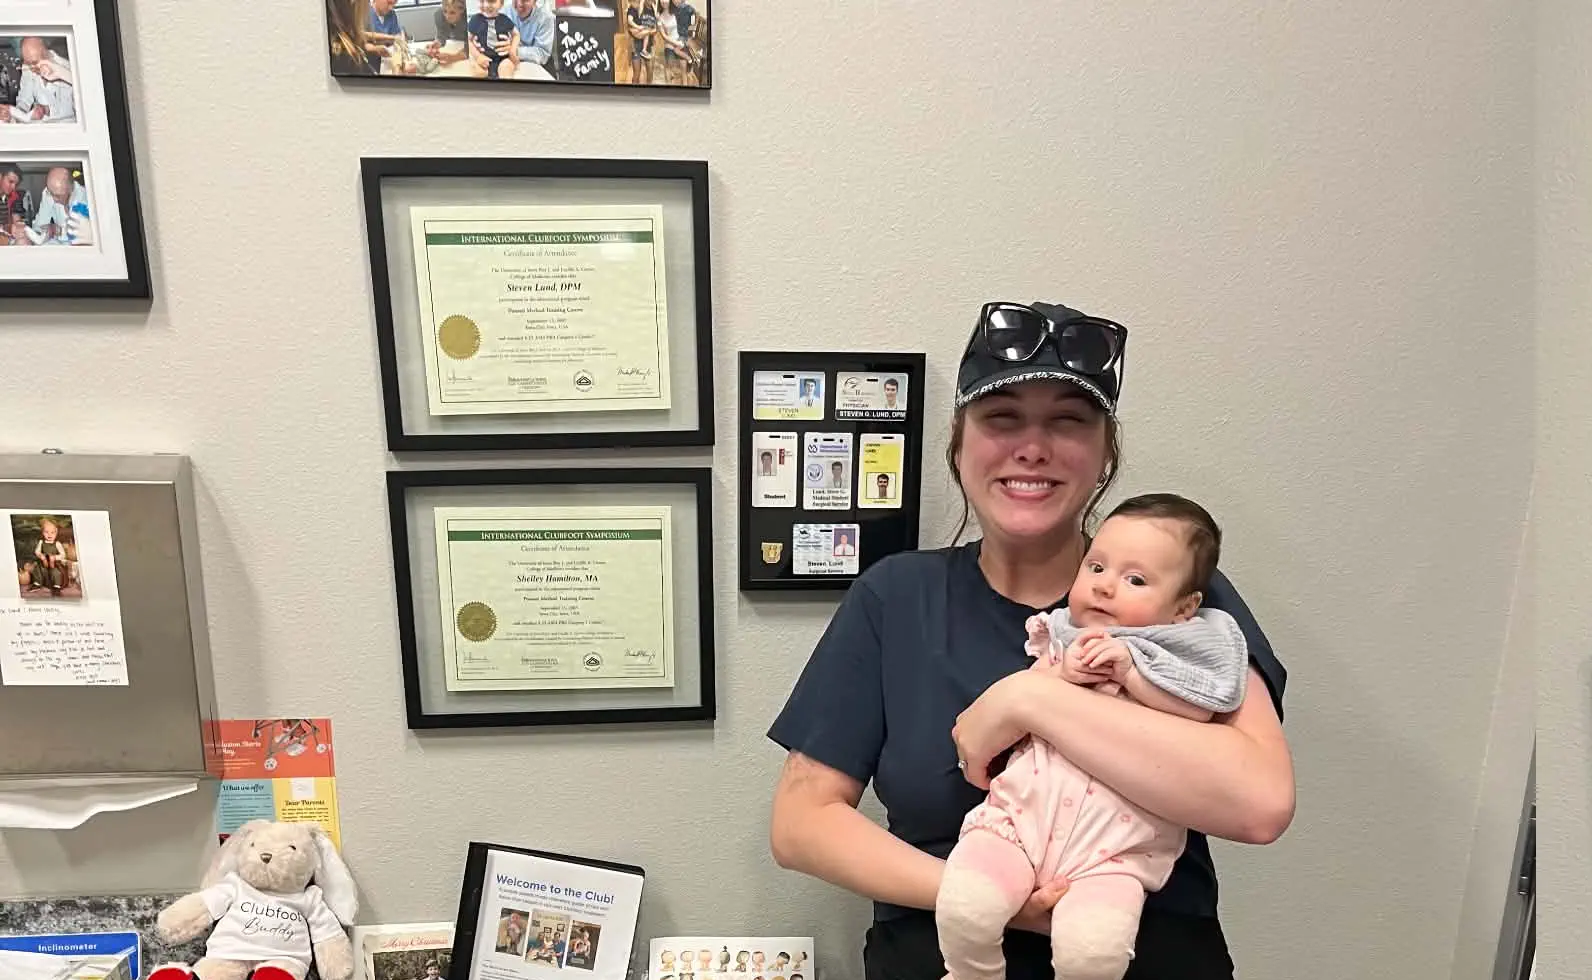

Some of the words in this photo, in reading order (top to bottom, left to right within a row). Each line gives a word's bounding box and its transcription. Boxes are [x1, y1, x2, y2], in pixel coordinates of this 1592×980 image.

[561, 31, 584, 49] The
[562, 37, 599, 67] Jones
[574, 49, 610, 77] Family
[507, 283, 532, 292] Steven
[560, 282, 581, 291] DPM
[481, 531, 543, 541] INTERNATIONAL
[544, 531, 585, 540] CLUBFOOT
[585, 530, 631, 540] SYMPOSIUM
[496, 873, 548, 892] Welcome
[550, 884, 562, 894] to
[564, 886, 582, 898] the
[585, 891, 614, 904] Club!
[240, 901, 302, 922] Clubfoot
[241, 916, 294, 942] Buddy
[38, 942, 97, 953] Inclinometer
